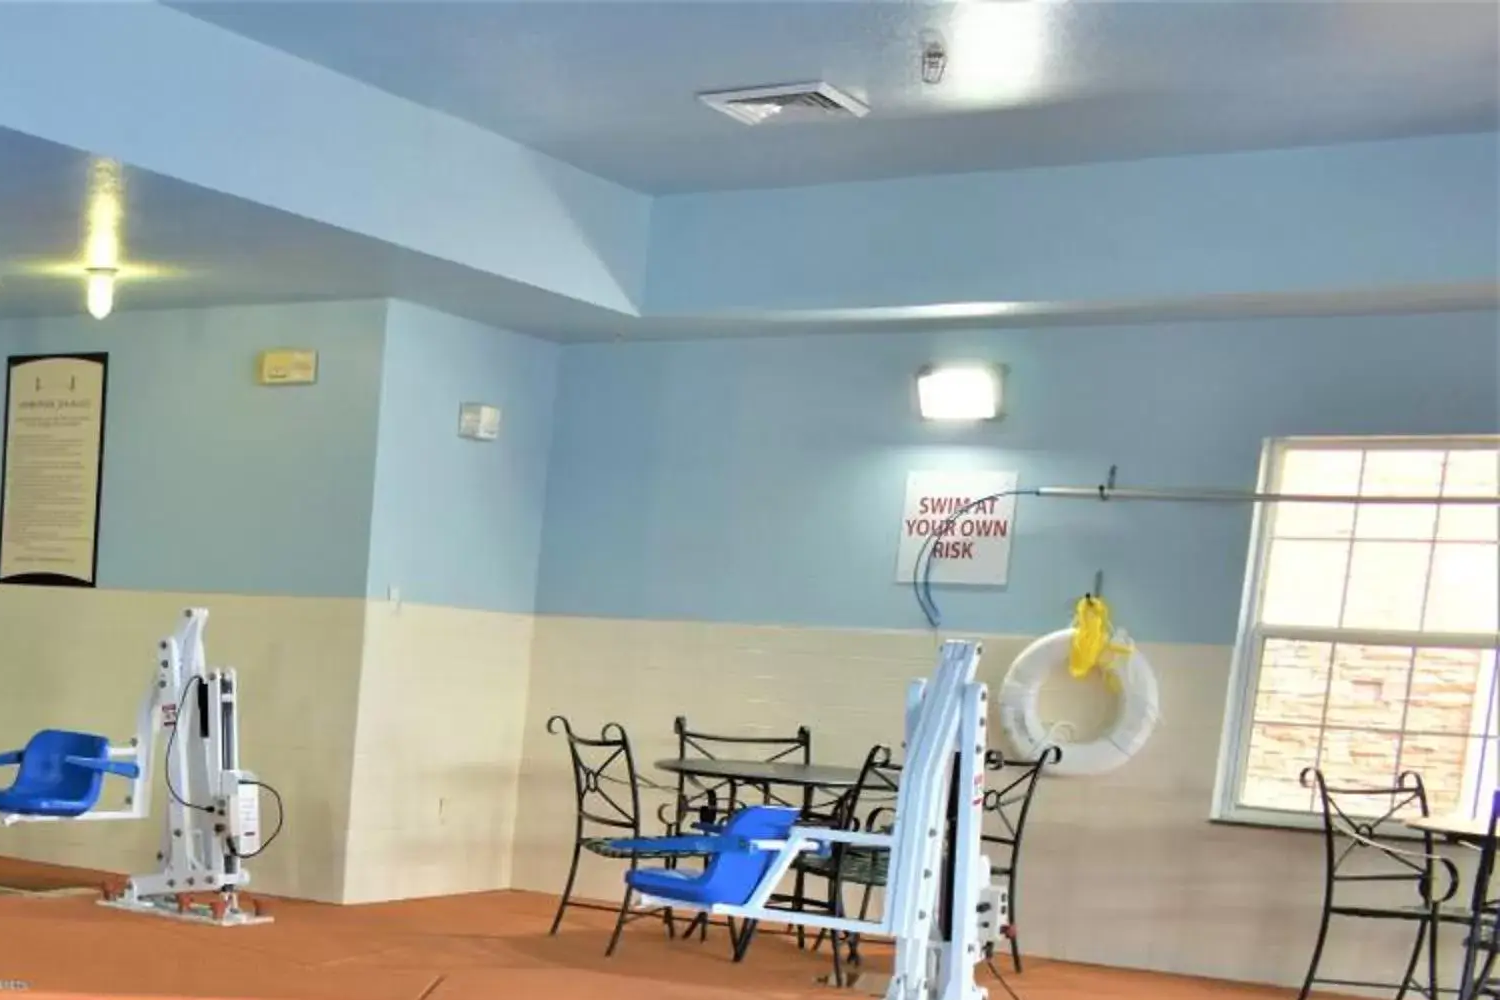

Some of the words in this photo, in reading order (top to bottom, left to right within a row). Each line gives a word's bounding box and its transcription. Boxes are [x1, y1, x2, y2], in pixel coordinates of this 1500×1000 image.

[975, 496, 998, 514] AT
[906, 519, 956, 537] YOUR
[961, 519, 1008, 537] OWN
[932, 541, 974, 559] RISK
